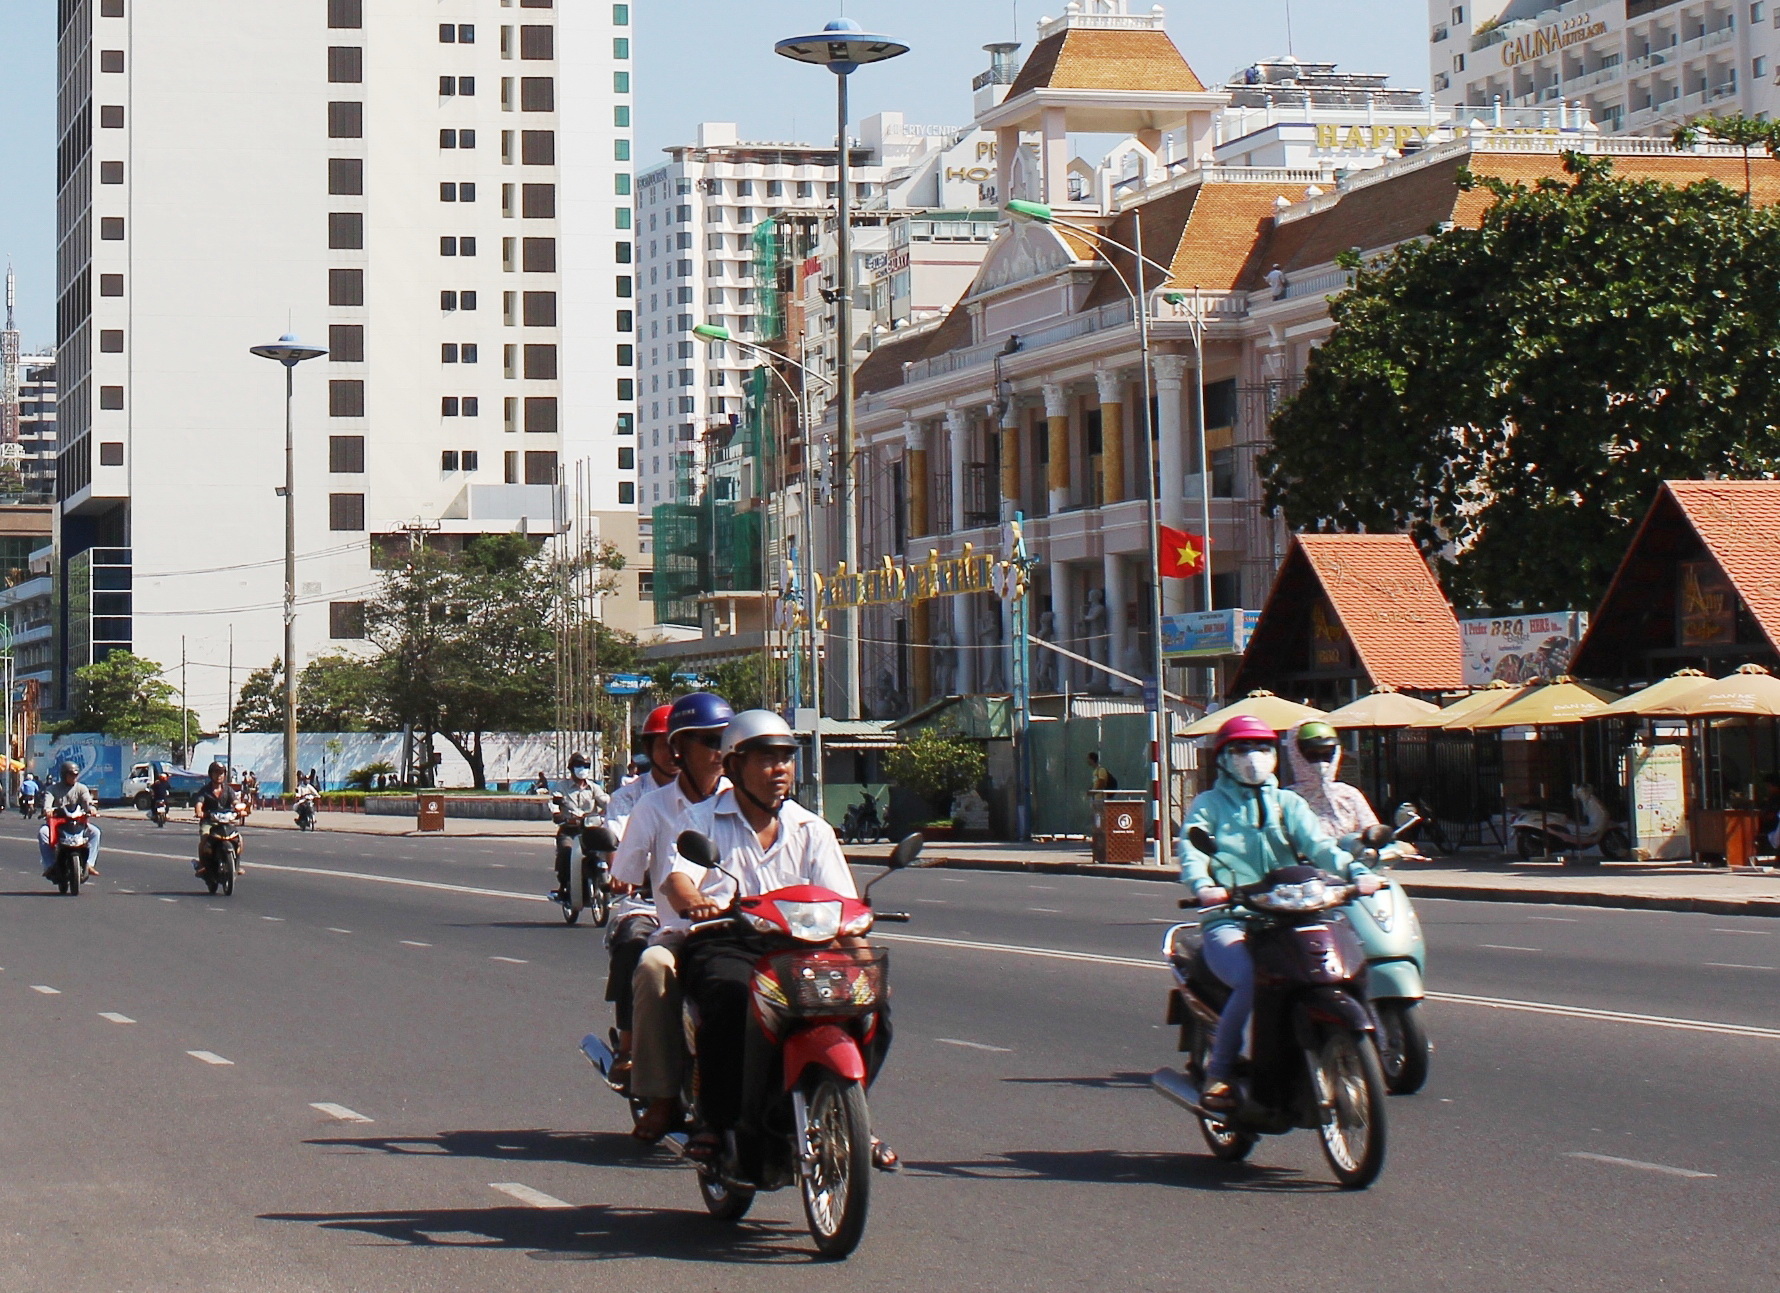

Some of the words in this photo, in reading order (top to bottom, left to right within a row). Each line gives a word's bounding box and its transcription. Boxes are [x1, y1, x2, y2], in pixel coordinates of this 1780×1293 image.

[1501, 24, 1562, 67] GALINA
[1316, 124, 1438, 149] HAPPY
[1491, 619, 1524, 636] BBQ
